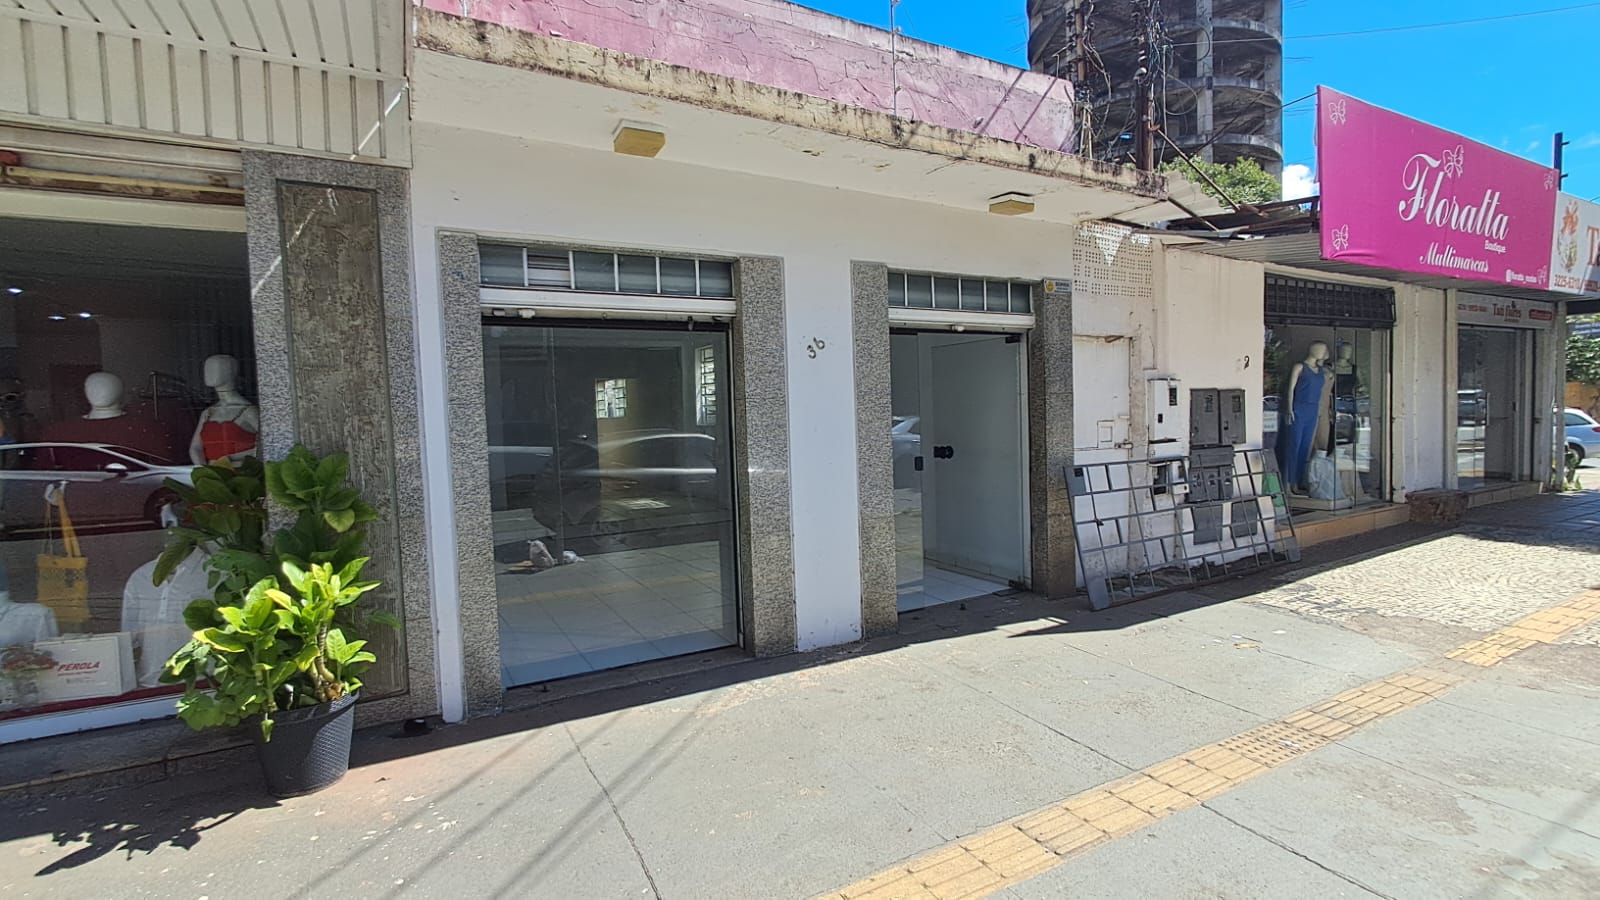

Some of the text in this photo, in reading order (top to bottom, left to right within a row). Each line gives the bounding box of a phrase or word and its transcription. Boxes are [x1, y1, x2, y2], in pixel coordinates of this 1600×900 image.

[1399, 153, 1509, 241] Floratta
[1419, 242, 1489, 273] Multimarcas
[806, 336, 826, 360] 36
